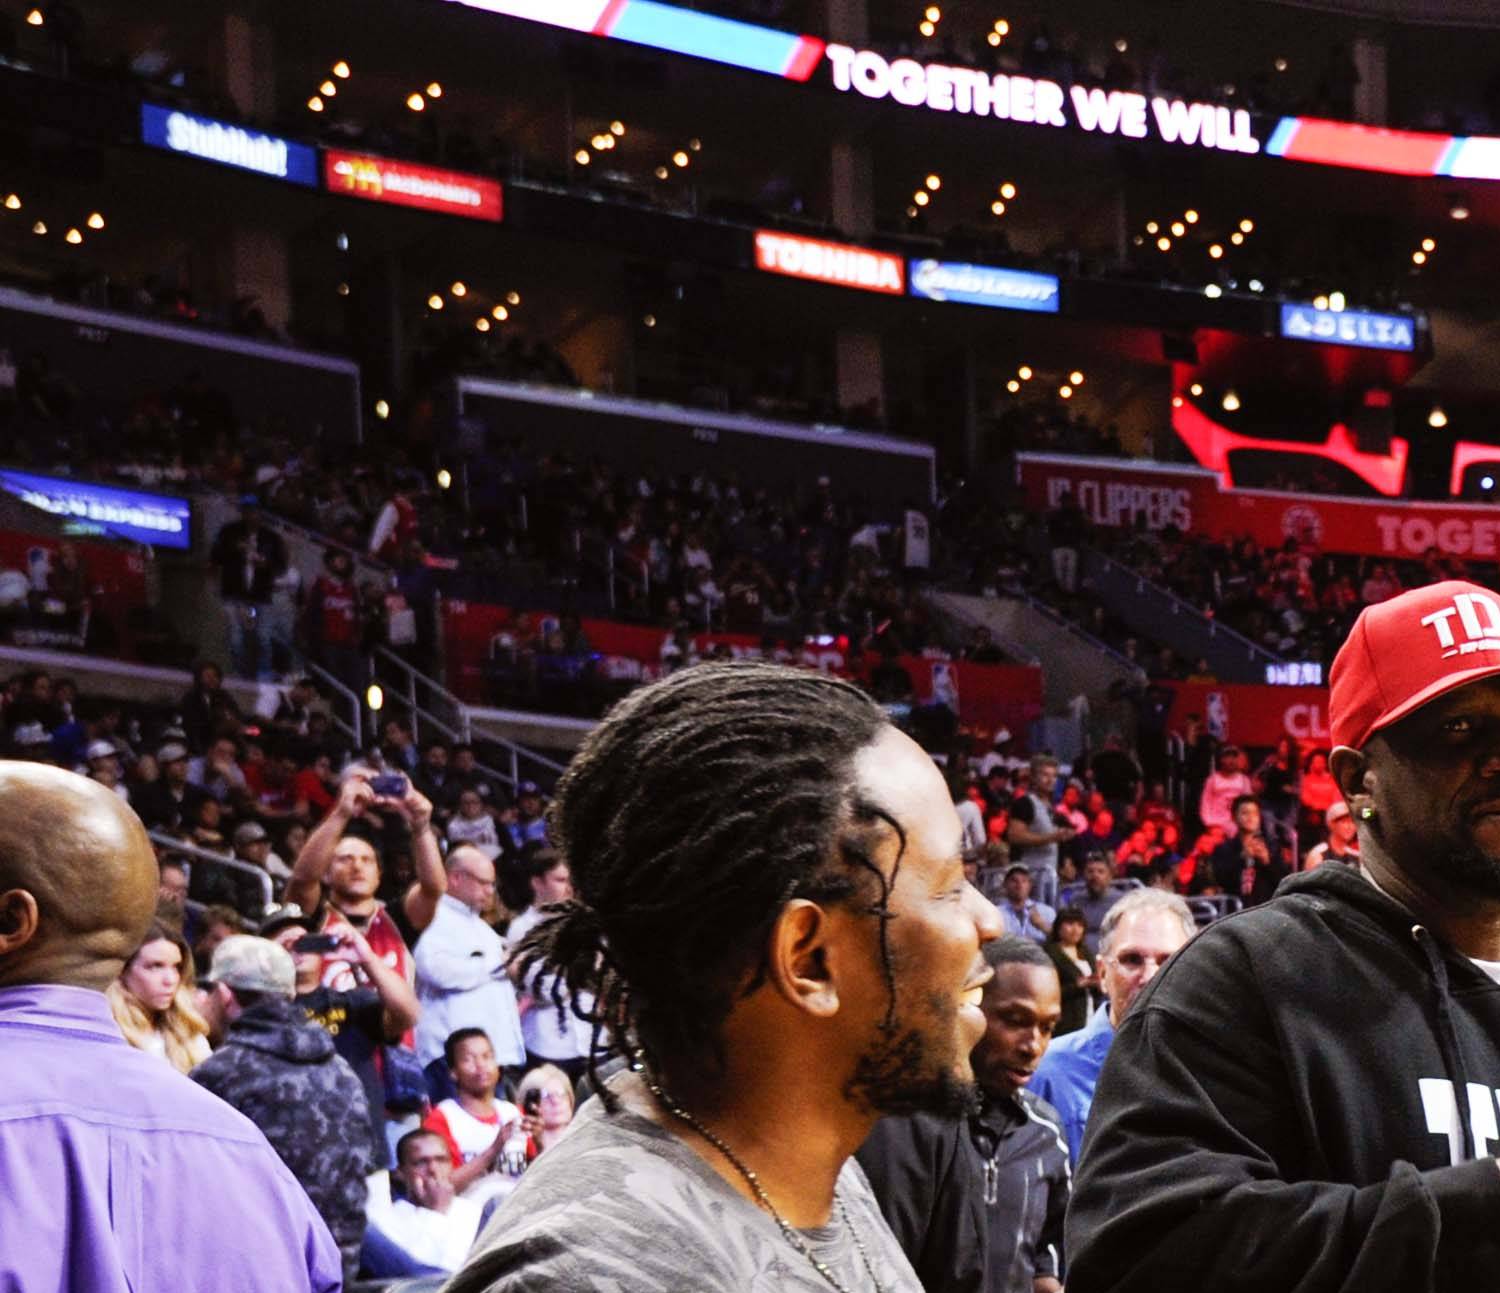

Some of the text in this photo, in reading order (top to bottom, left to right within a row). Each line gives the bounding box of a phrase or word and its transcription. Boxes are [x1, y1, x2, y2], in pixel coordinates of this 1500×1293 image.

[826, 43, 1260, 154] TOGETHER WE WILL
[755, 233, 901, 290] TOSHIBA
[1311, 313, 1412, 346] DELTA
[1079, 480, 1192, 533] CLIPPERS
